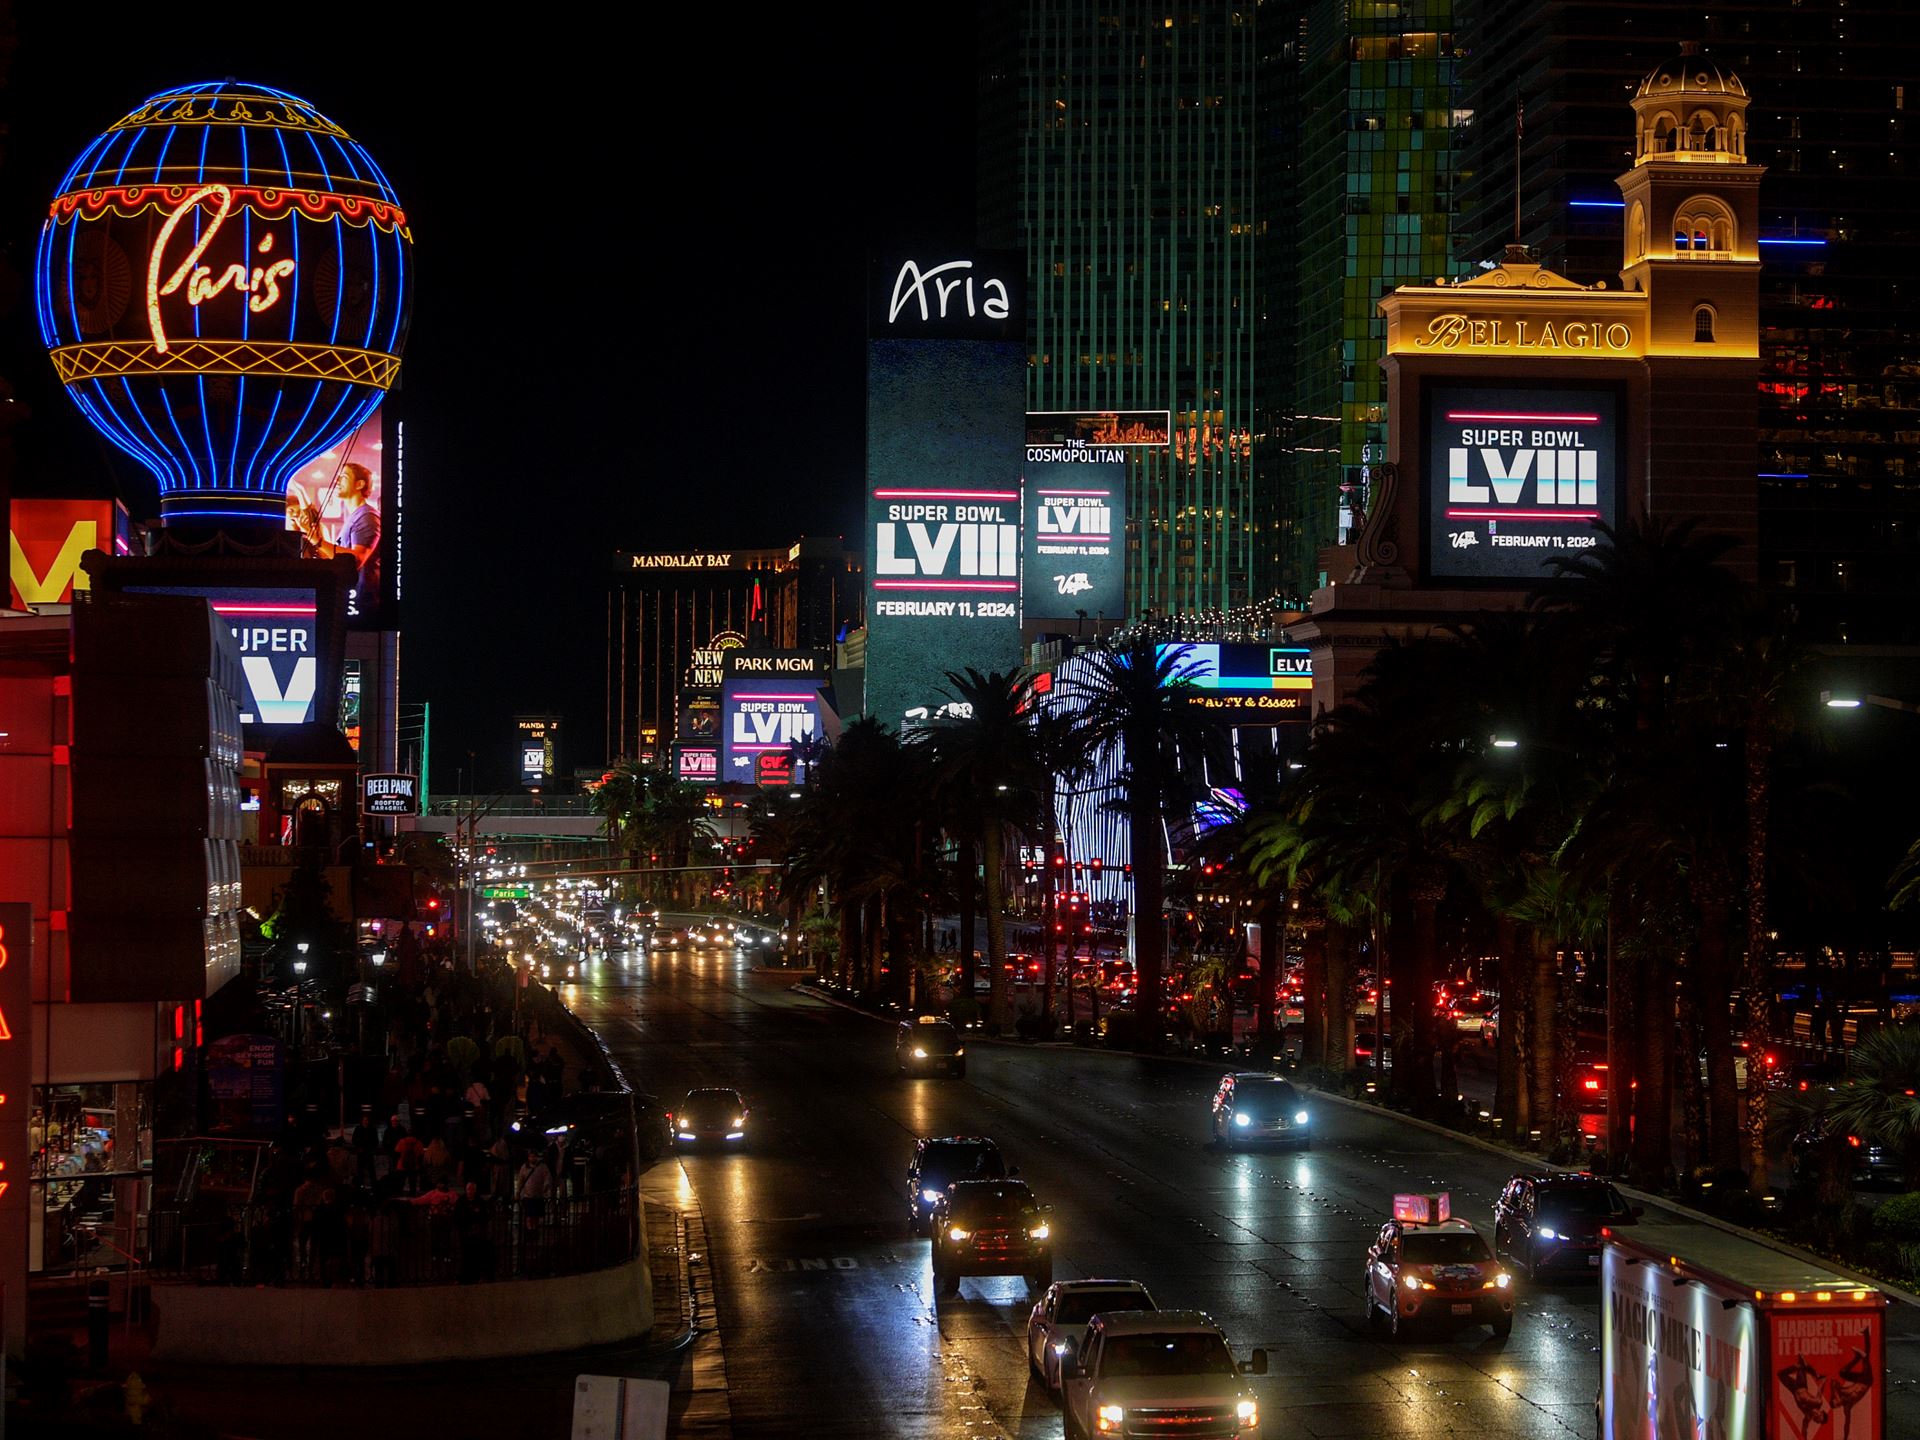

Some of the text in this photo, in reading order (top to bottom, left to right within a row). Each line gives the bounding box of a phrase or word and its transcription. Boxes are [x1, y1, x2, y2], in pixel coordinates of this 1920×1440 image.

[146, 183, 296, 354] Paris
[889, 260, 1009, 323] Aria
[1415, 314, 1632, 350] BELLAGIO
[1066, 440, 1086, 448] THE
[1462, 429, 1585, 447] SUPER BOWL
[1027, 449, 1124, 463] COSMOPOLITAN
[1449, 448, 1597, 505] LVIII
[1044, 498, 1104, 507] SUPER BOWL
[889, 505, 1006, 522] SUPER BOWL
[1037, 506, 1110, 534] LVIII
[876, 523, 1017, 576] LVIII
[1491, 535, 1596, 549] FEBRUARY 11, 2024
[632, 554, 731, 567] MANDALAY BAY
[876, 601, 1016, 618] FEBRUARY 11, 2024
[231, 628, 308, 652] UPER
[695, 650, 724, 666] NEW
[735, 657, 814, 671] PARK MGM
[694, 669, 724, 684] NEW
[239, 656, 316, 723] V
[741, 703, 808, 713] SUPER BOWL
[1244, 696, 1256, 708] &
[1258, 695, 1297, 708] Essex
[733, 712, 815, 743] LVIII
[680, 757, 716, 771] LVIII
[367, 779, 413, 797] BEER PARK
[493, 889, 515, 898] Paris
[1612, 1290, 1657, 1350] MAGIC
[1659, 1312, 1701, 1372] MIKE
[1778, 1318, 1872, 1337] HARDER THAN
[1778, 1338, 1843, 1356] IT LOOKS.
